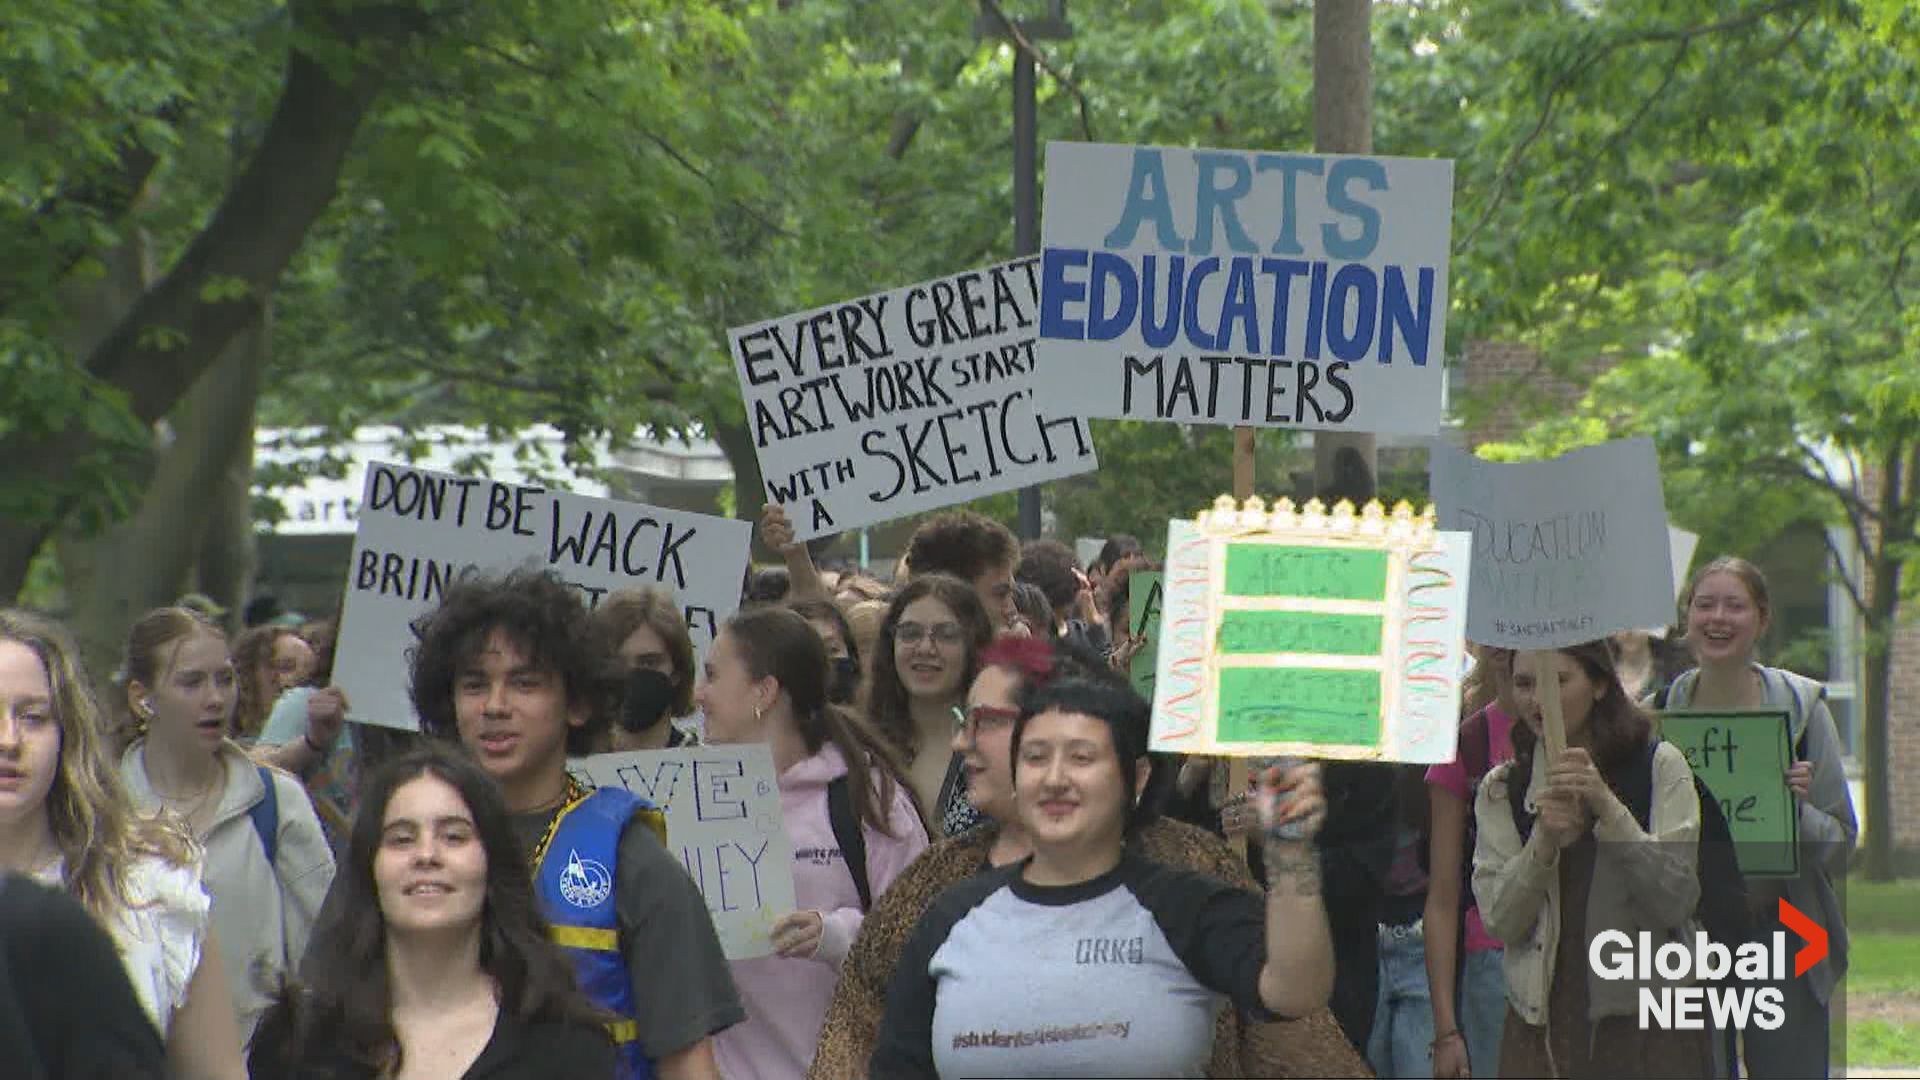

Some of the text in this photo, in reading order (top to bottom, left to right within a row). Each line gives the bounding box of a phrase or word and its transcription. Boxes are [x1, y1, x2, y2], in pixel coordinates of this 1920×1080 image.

[1104, 149, 1389, 260] ARTS
[739, 258, 1040, 386] EVERY GREAT
[1040, 247, 1434, 366] EDUCATION
[751, 338, 1036, 448] ARTWORK START
[1123, 356, 1354, 422] MATTERS
[768, 388, 1091, 504] WITH SKETCH
[369, 467, 696, 590] DON'T BE WACK
[811, 498, 834, 532] A
[357, 549, 478, 600] BRIN
[1686, 727, 1738, 773] eft
